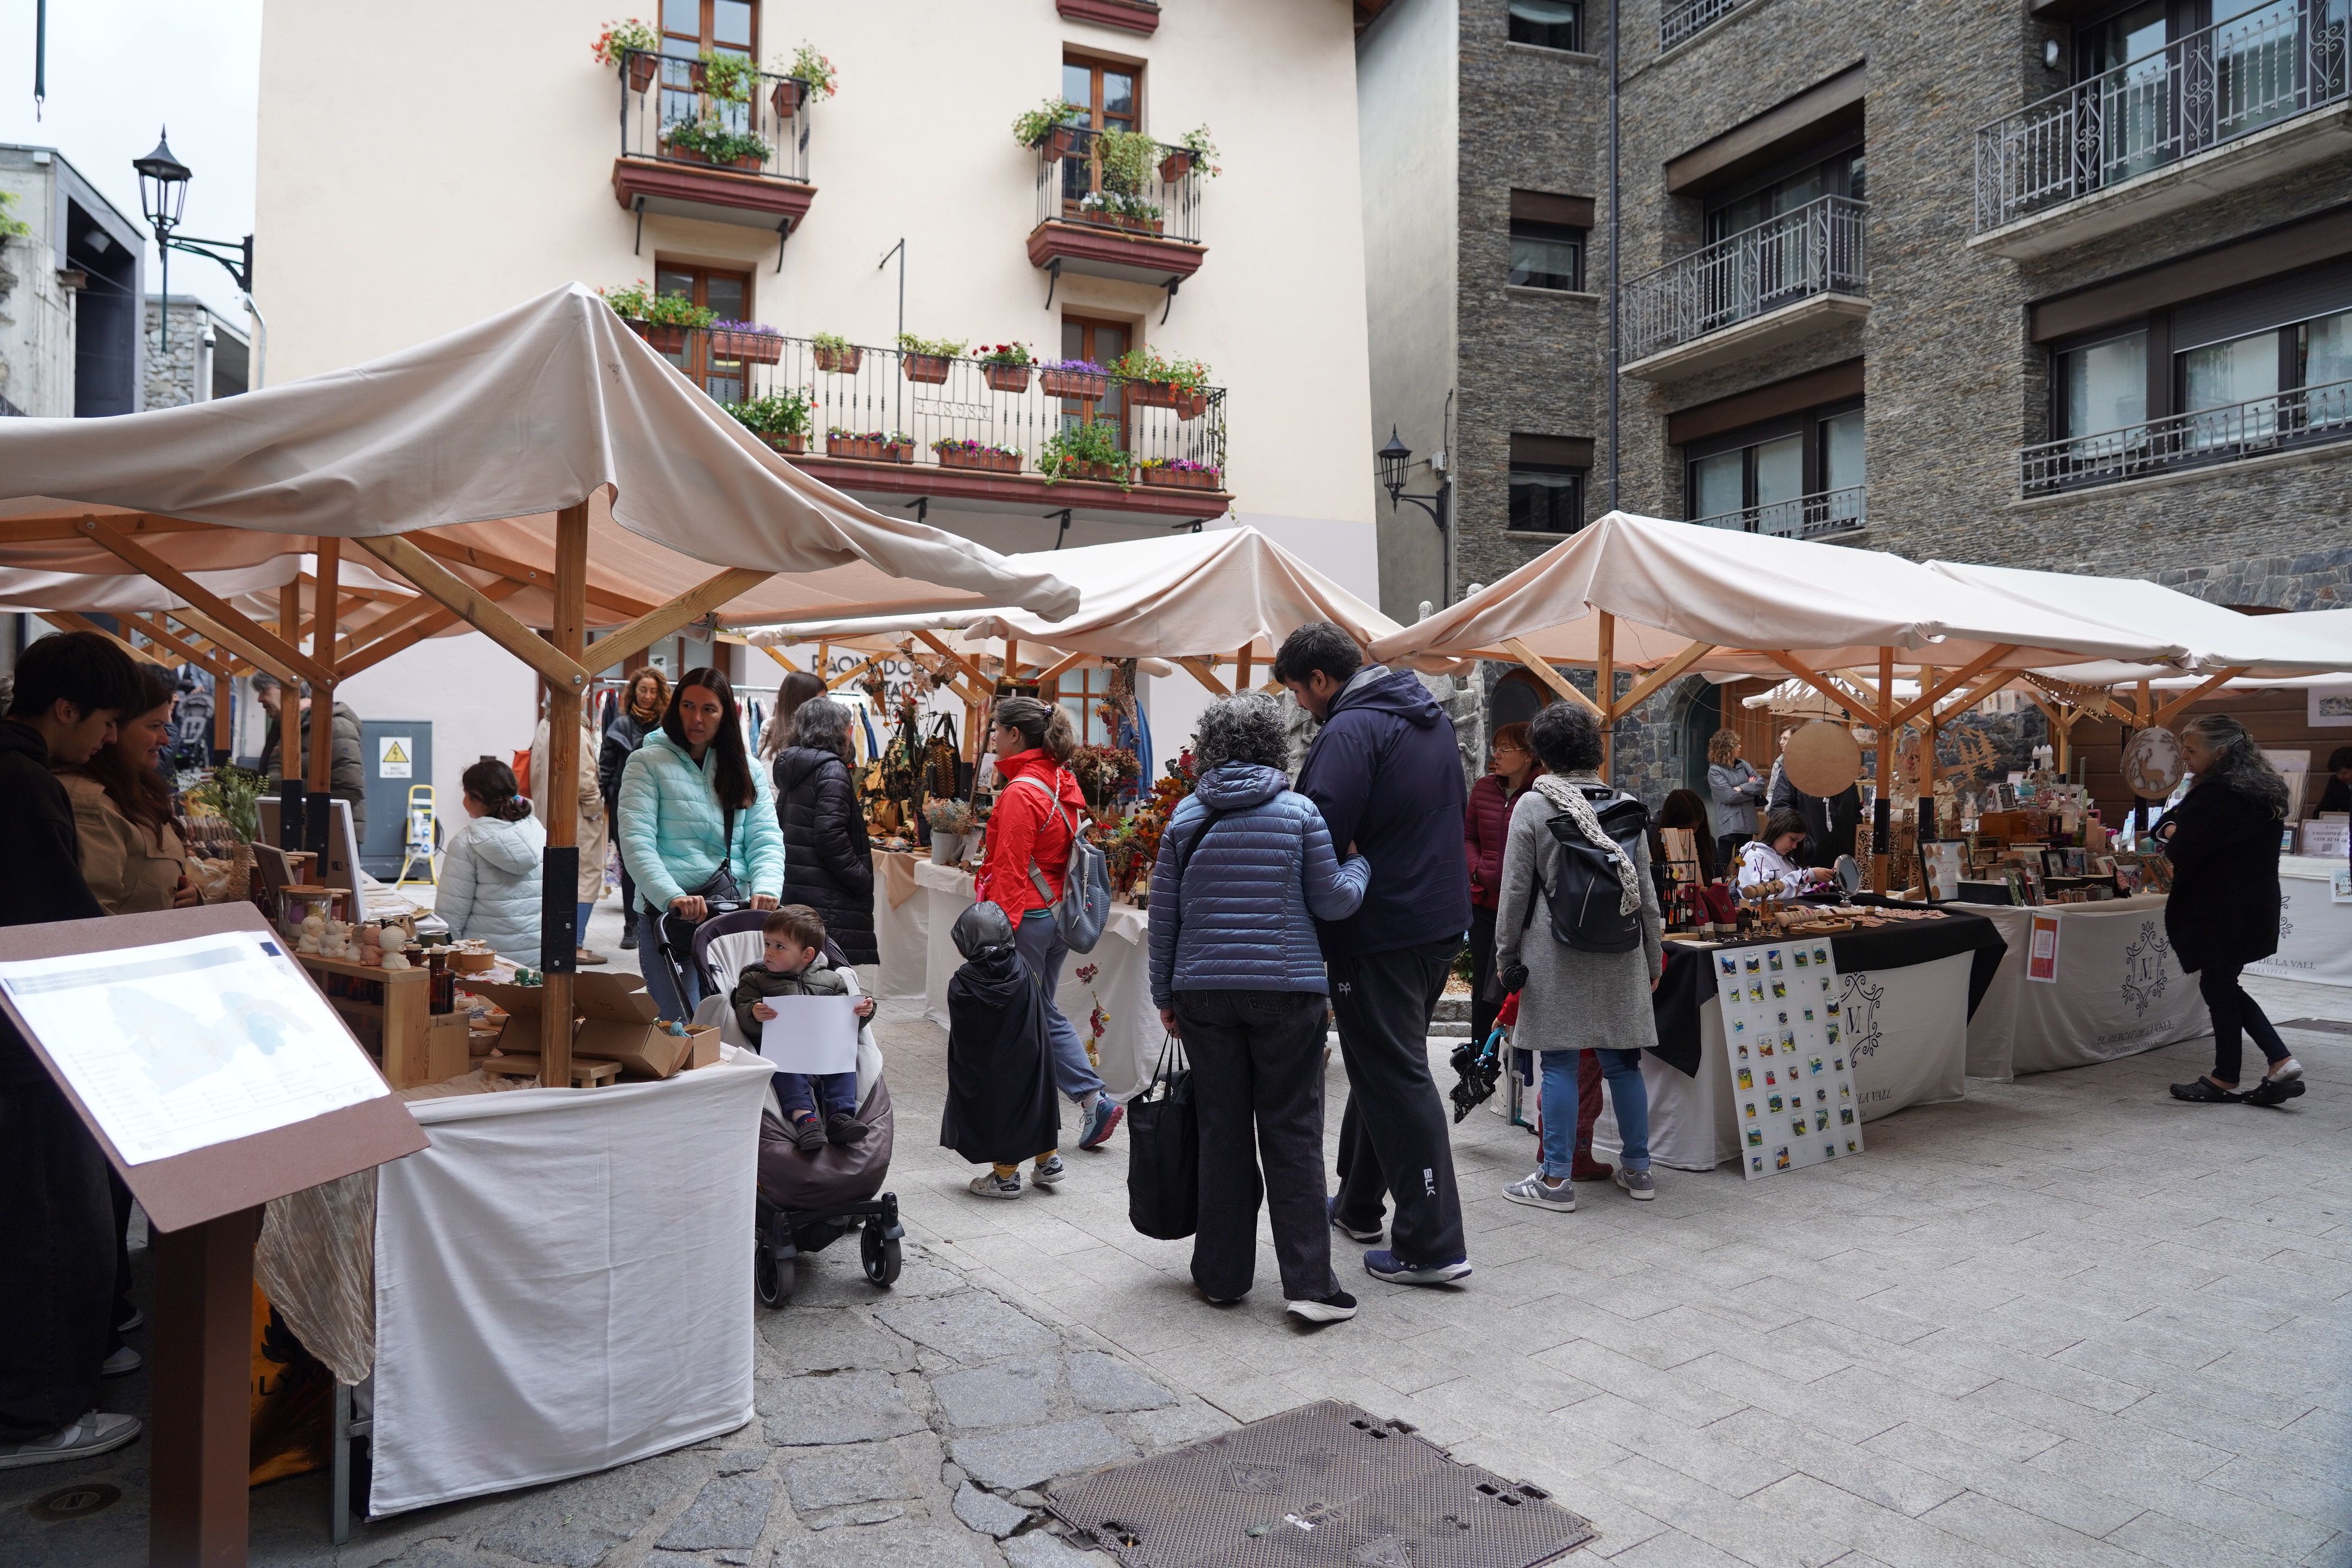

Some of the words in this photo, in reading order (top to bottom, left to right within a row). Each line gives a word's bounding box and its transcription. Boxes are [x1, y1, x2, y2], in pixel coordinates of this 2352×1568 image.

[933, 402, 976, 419] 1898
[2139, 957, 2153, 981] M
[2275, 958, 2288, 967] LA
[2290, 960, 2316, 970] VALL
[1846, 1006, 1862, 1035] M
[2097, 1035, 2106, 1045] EL
[2106, 1030, 2136, 1043] MERCAT
[2136, 1027, 2145, 1039] DE
[2154, 1020, 2175, 1034] VALL
[1858, 1093, 1869, 1104] LA
[1871, 1088, 1891, 1102] VALL
[1423, 1168, 1436, 1197] BLK
